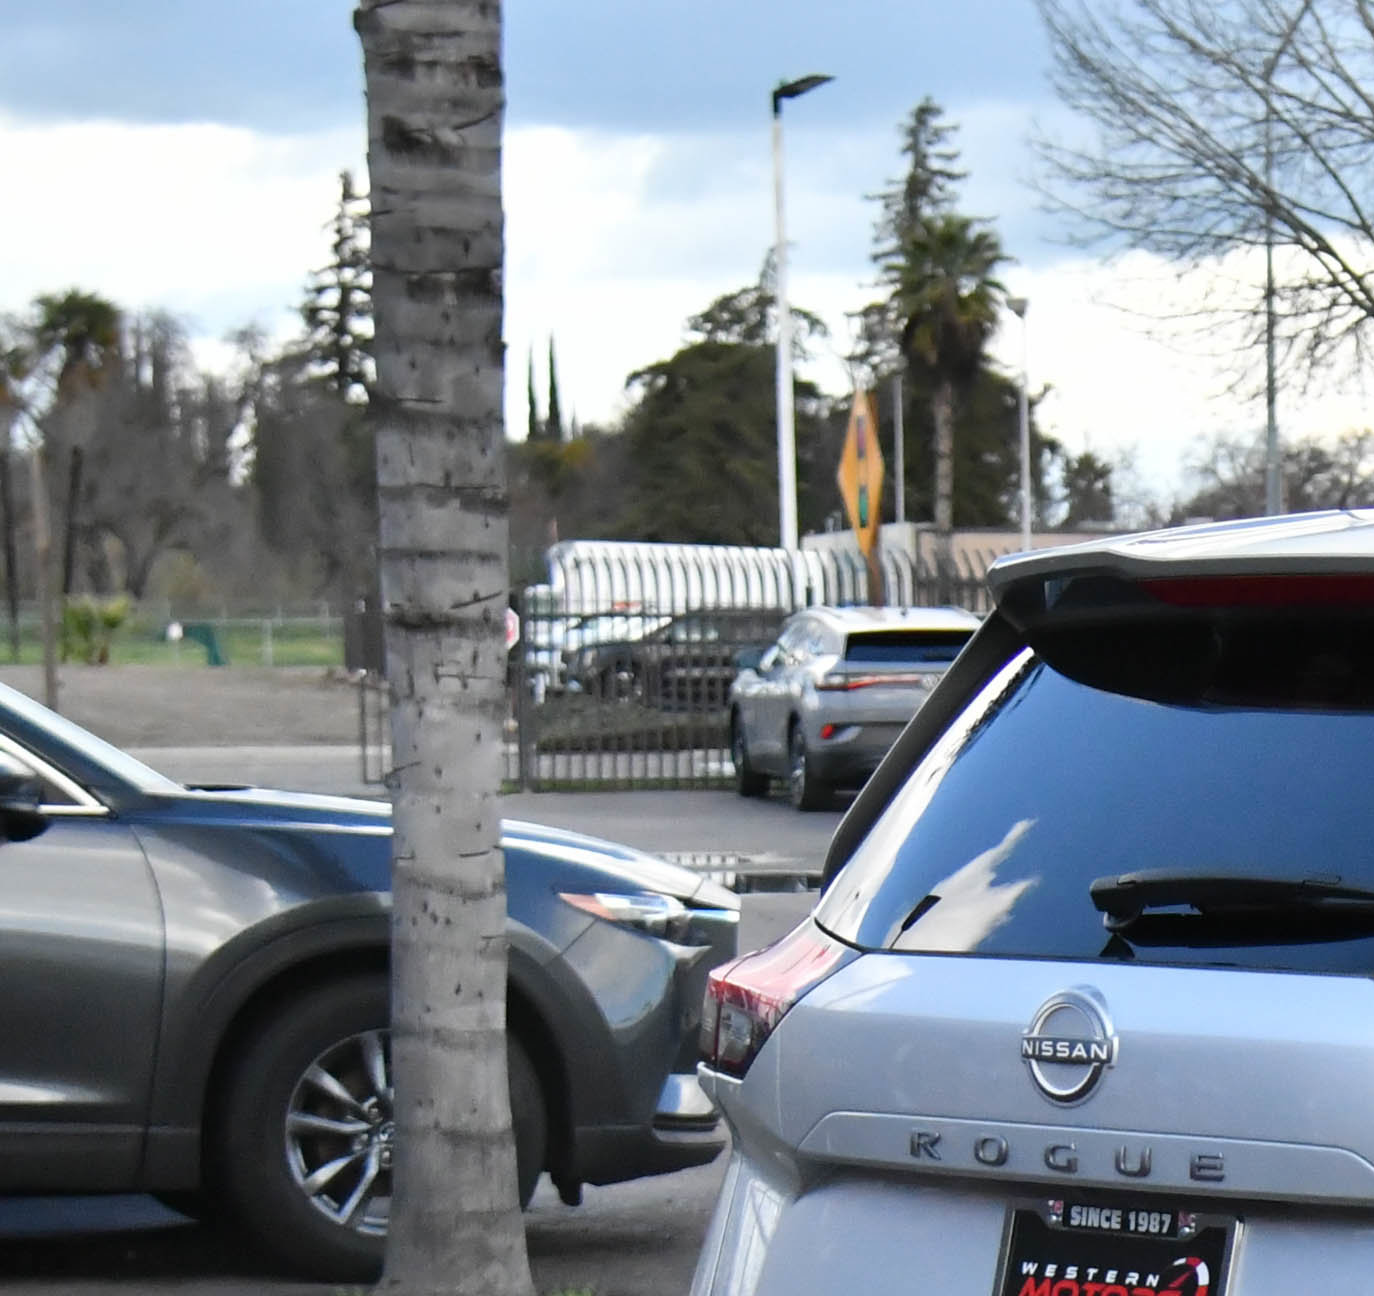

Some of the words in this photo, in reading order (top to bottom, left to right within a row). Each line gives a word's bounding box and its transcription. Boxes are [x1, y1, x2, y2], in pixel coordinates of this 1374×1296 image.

[1021, 1038, 1108, 1061] NISSAN
[910, 1131, 1226, 1182] ROGUE
[1070, 1205, 1121, 1230] SINCE
[1128, 1210, 1172, 1234] 1987
[1022, 1261, 1160, 1288] WESTERN
